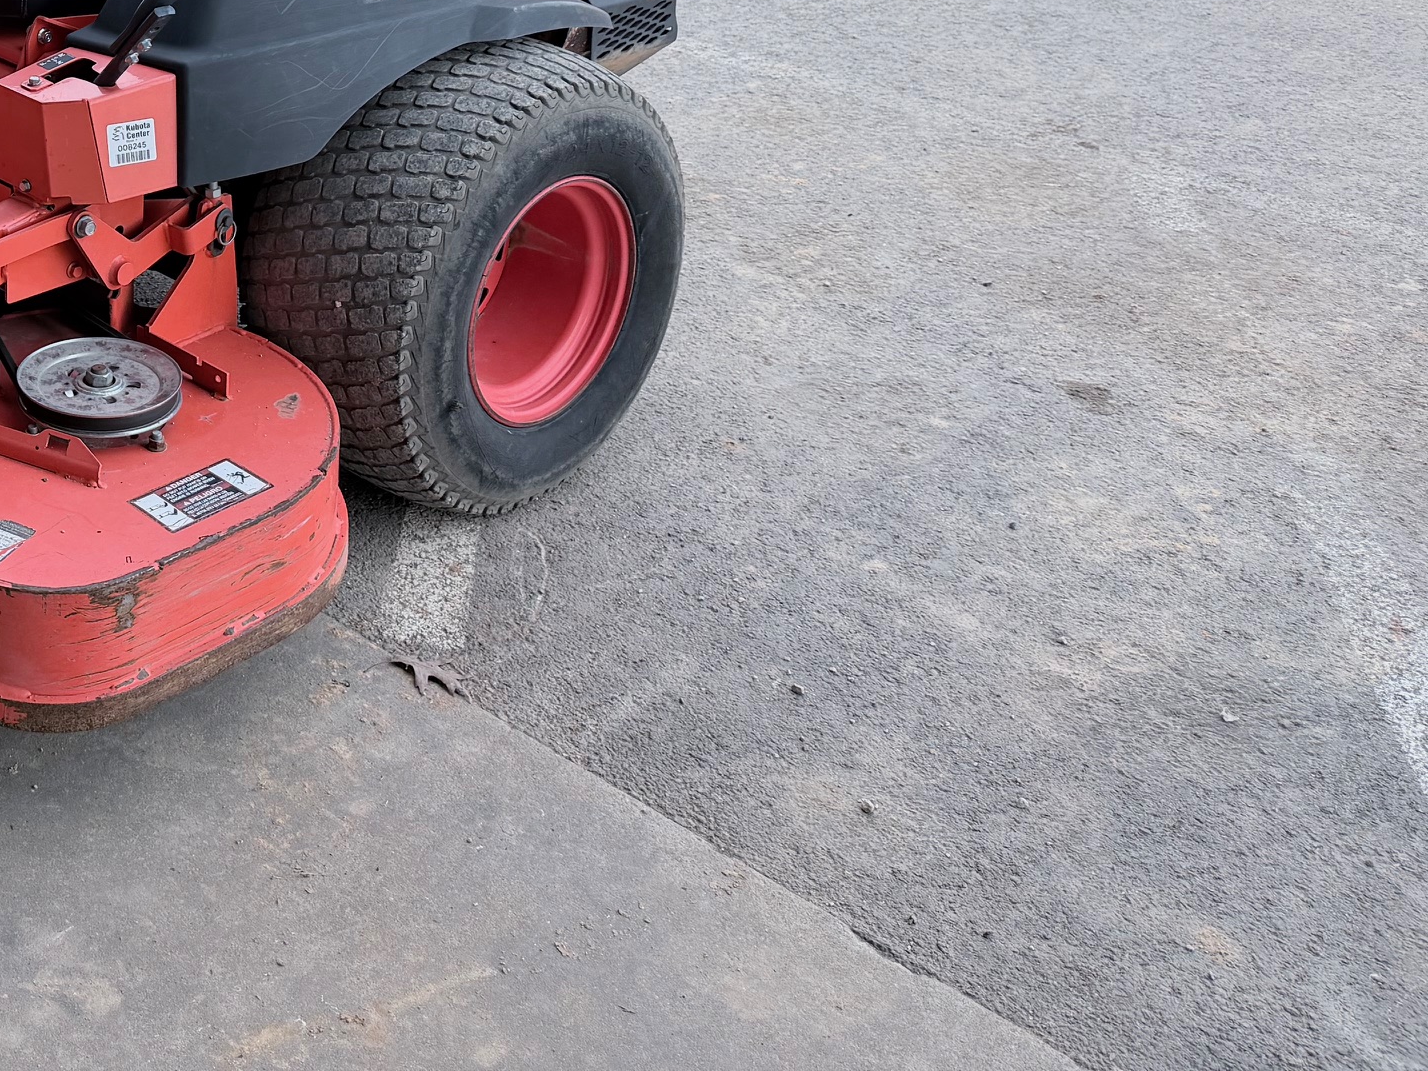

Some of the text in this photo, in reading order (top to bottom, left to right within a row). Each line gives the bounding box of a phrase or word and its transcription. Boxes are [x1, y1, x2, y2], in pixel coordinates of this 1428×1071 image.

[126, 122, 151, 131] Kubota
[126, 131, 150, 139] Center
[117, 141, 147, 152] 008245
[189, 486, 224, 504] PELIGRO
